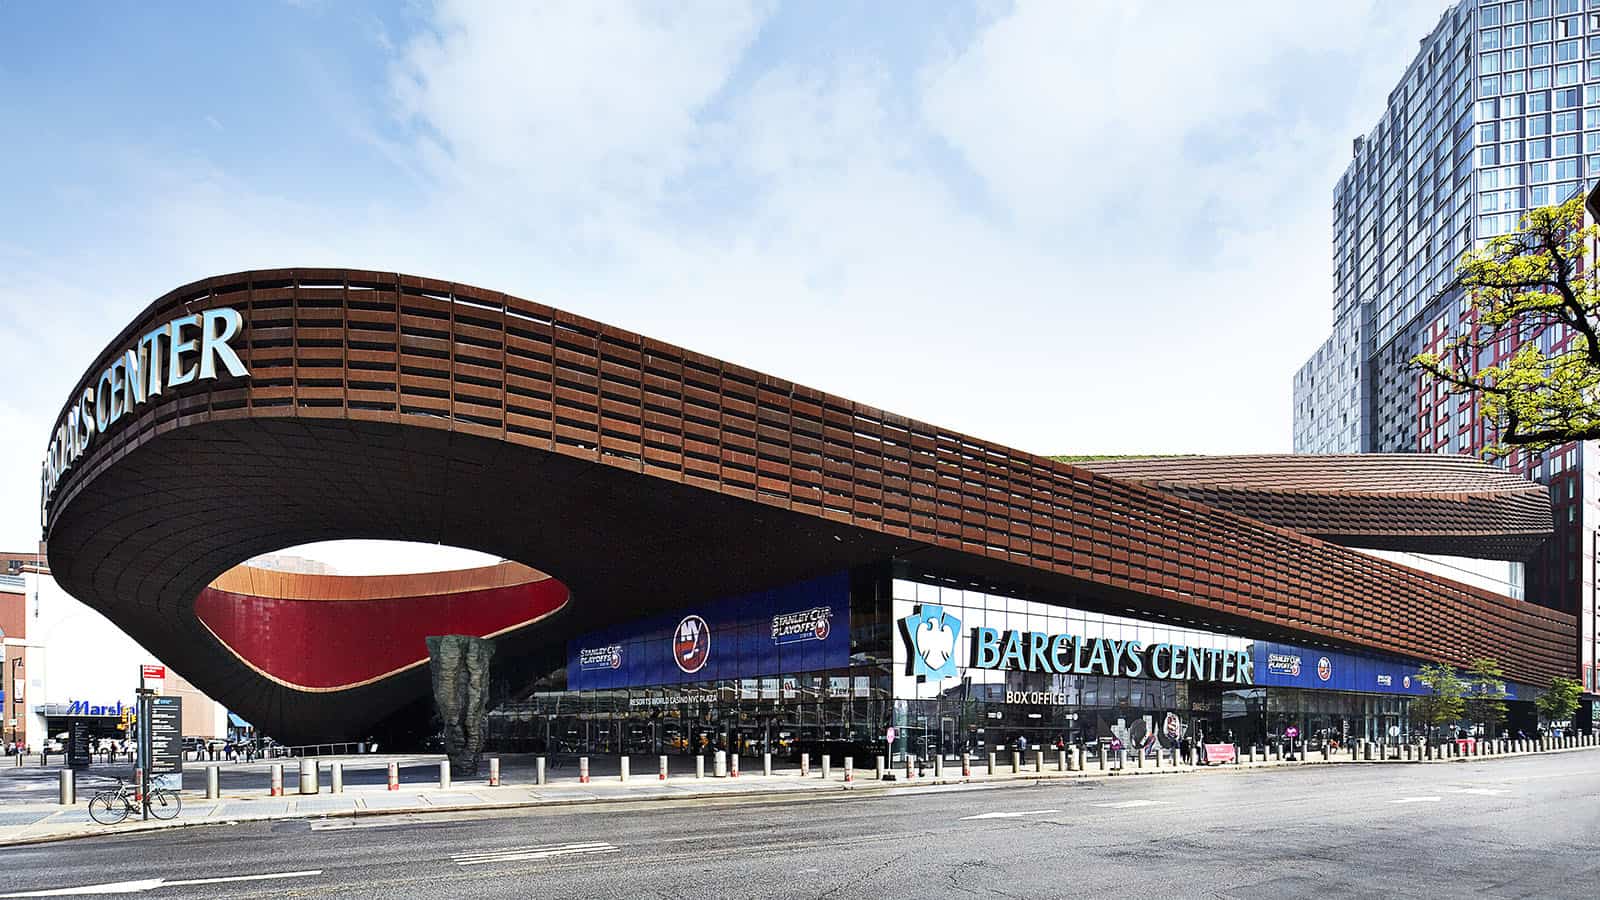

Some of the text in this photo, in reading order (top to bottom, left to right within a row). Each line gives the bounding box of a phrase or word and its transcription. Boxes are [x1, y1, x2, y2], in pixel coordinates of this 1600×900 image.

[41, 307, 251, 526] ARCLAYS CENTER
[772, 609, 831, 628] STANLEY CUP
[772, 621, 816, 638] PLAYOFFS
[975, 627, 1253, 685] BARCLAYS CENTER
[700, 694, 718, 702] PLAZA
[1007, 690, 1066, 705] BOX OFFICE
